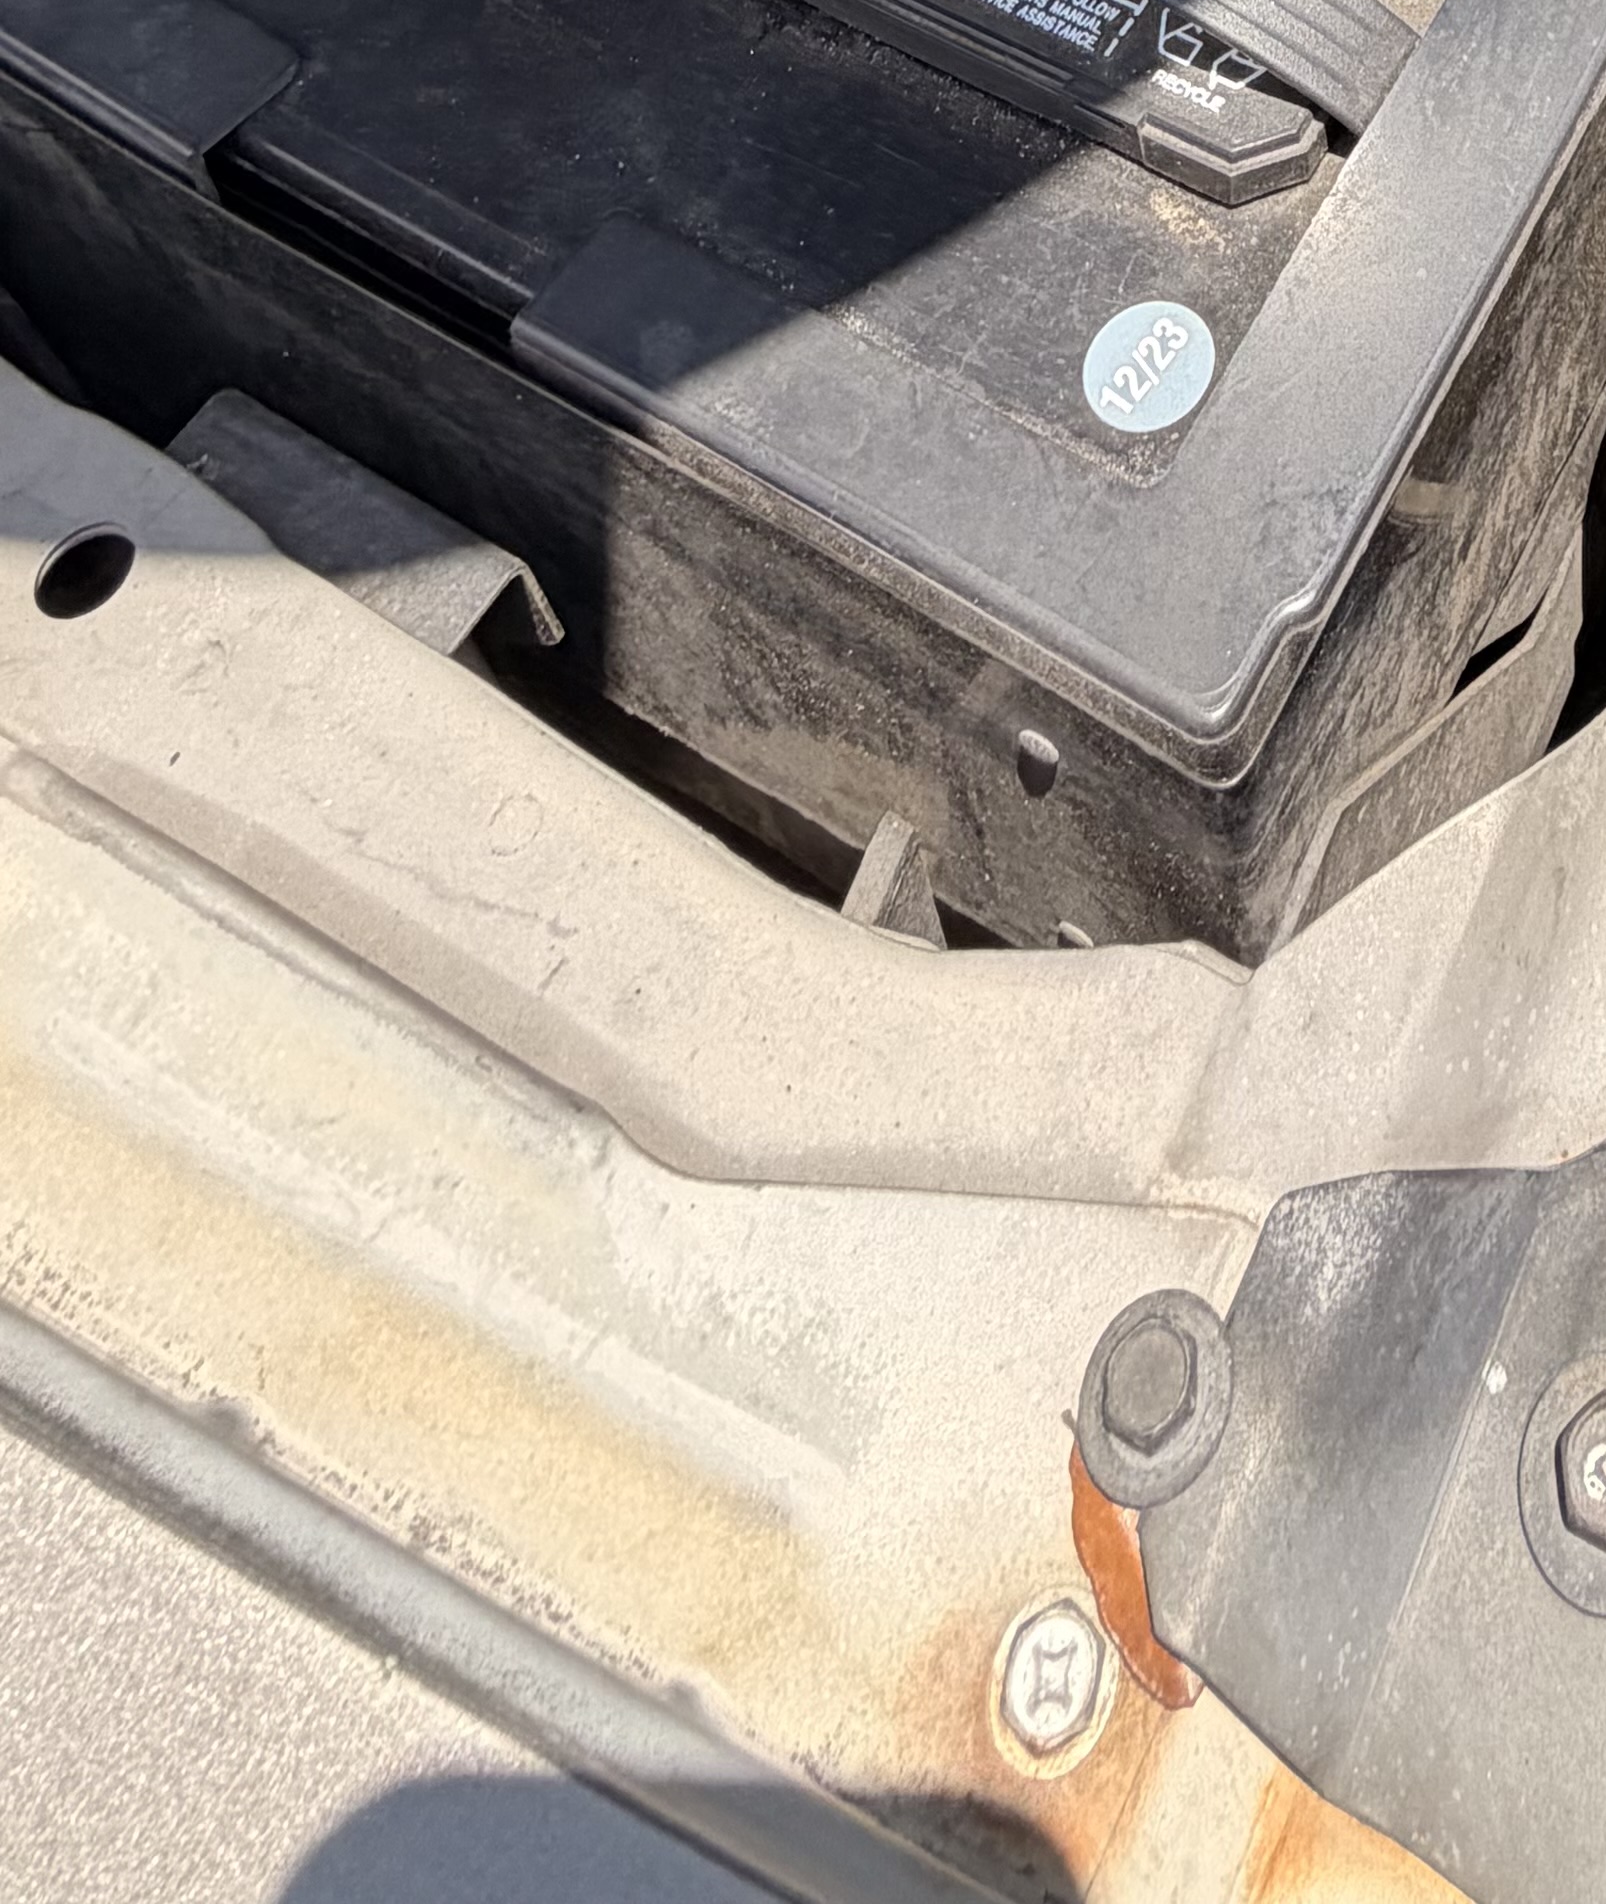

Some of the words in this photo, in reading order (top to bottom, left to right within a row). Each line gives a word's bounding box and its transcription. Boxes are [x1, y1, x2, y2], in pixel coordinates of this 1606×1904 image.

[1048, 0, 1103, 36] MANUAL
[1151, 69, 1226, 113] RECYCLE
[1099, 317, 1189, 415] 12/23
